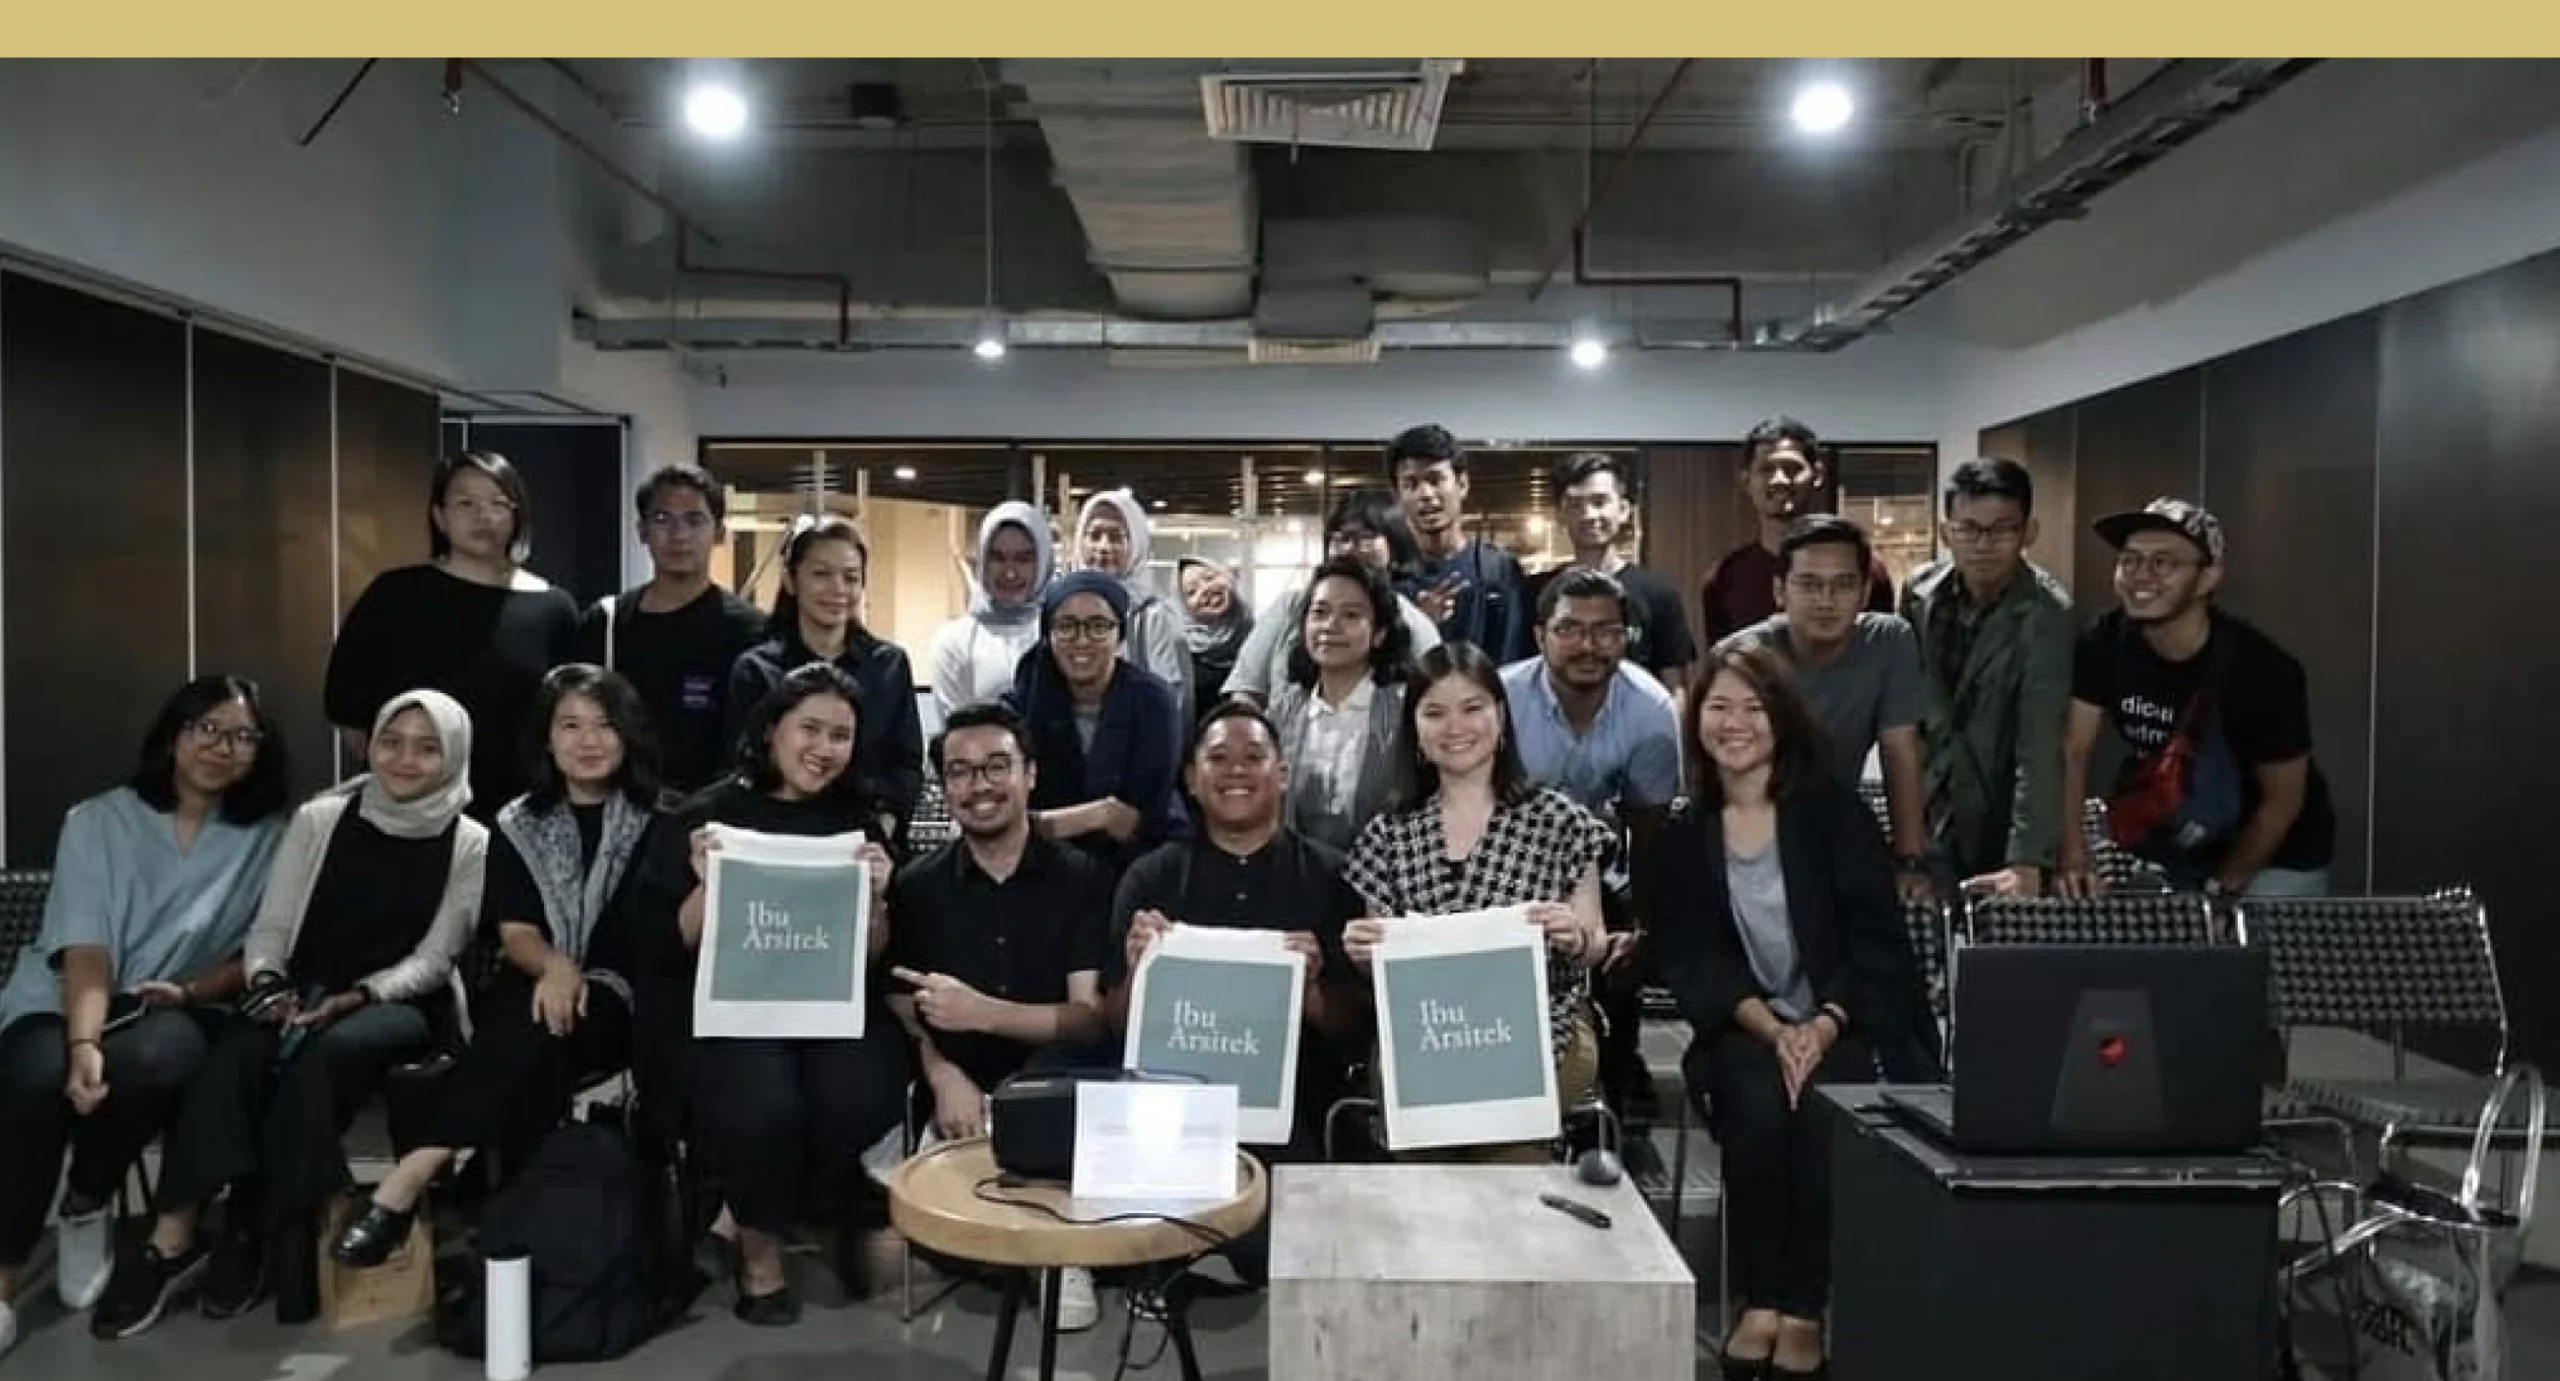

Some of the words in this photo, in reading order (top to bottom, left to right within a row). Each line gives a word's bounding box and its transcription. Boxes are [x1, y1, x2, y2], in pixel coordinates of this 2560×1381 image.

[746, 900, 790, 928] Ibu
[742, 924, 830, 951] Arsitek
[1172, 999, 1217, 1028] Ibu
[1420, 998, 1464, 1025] Ibu
[1166, 1027, 1261, 1056] Arsitek
[1420, 1017, 1513, 1052] Arsitek
